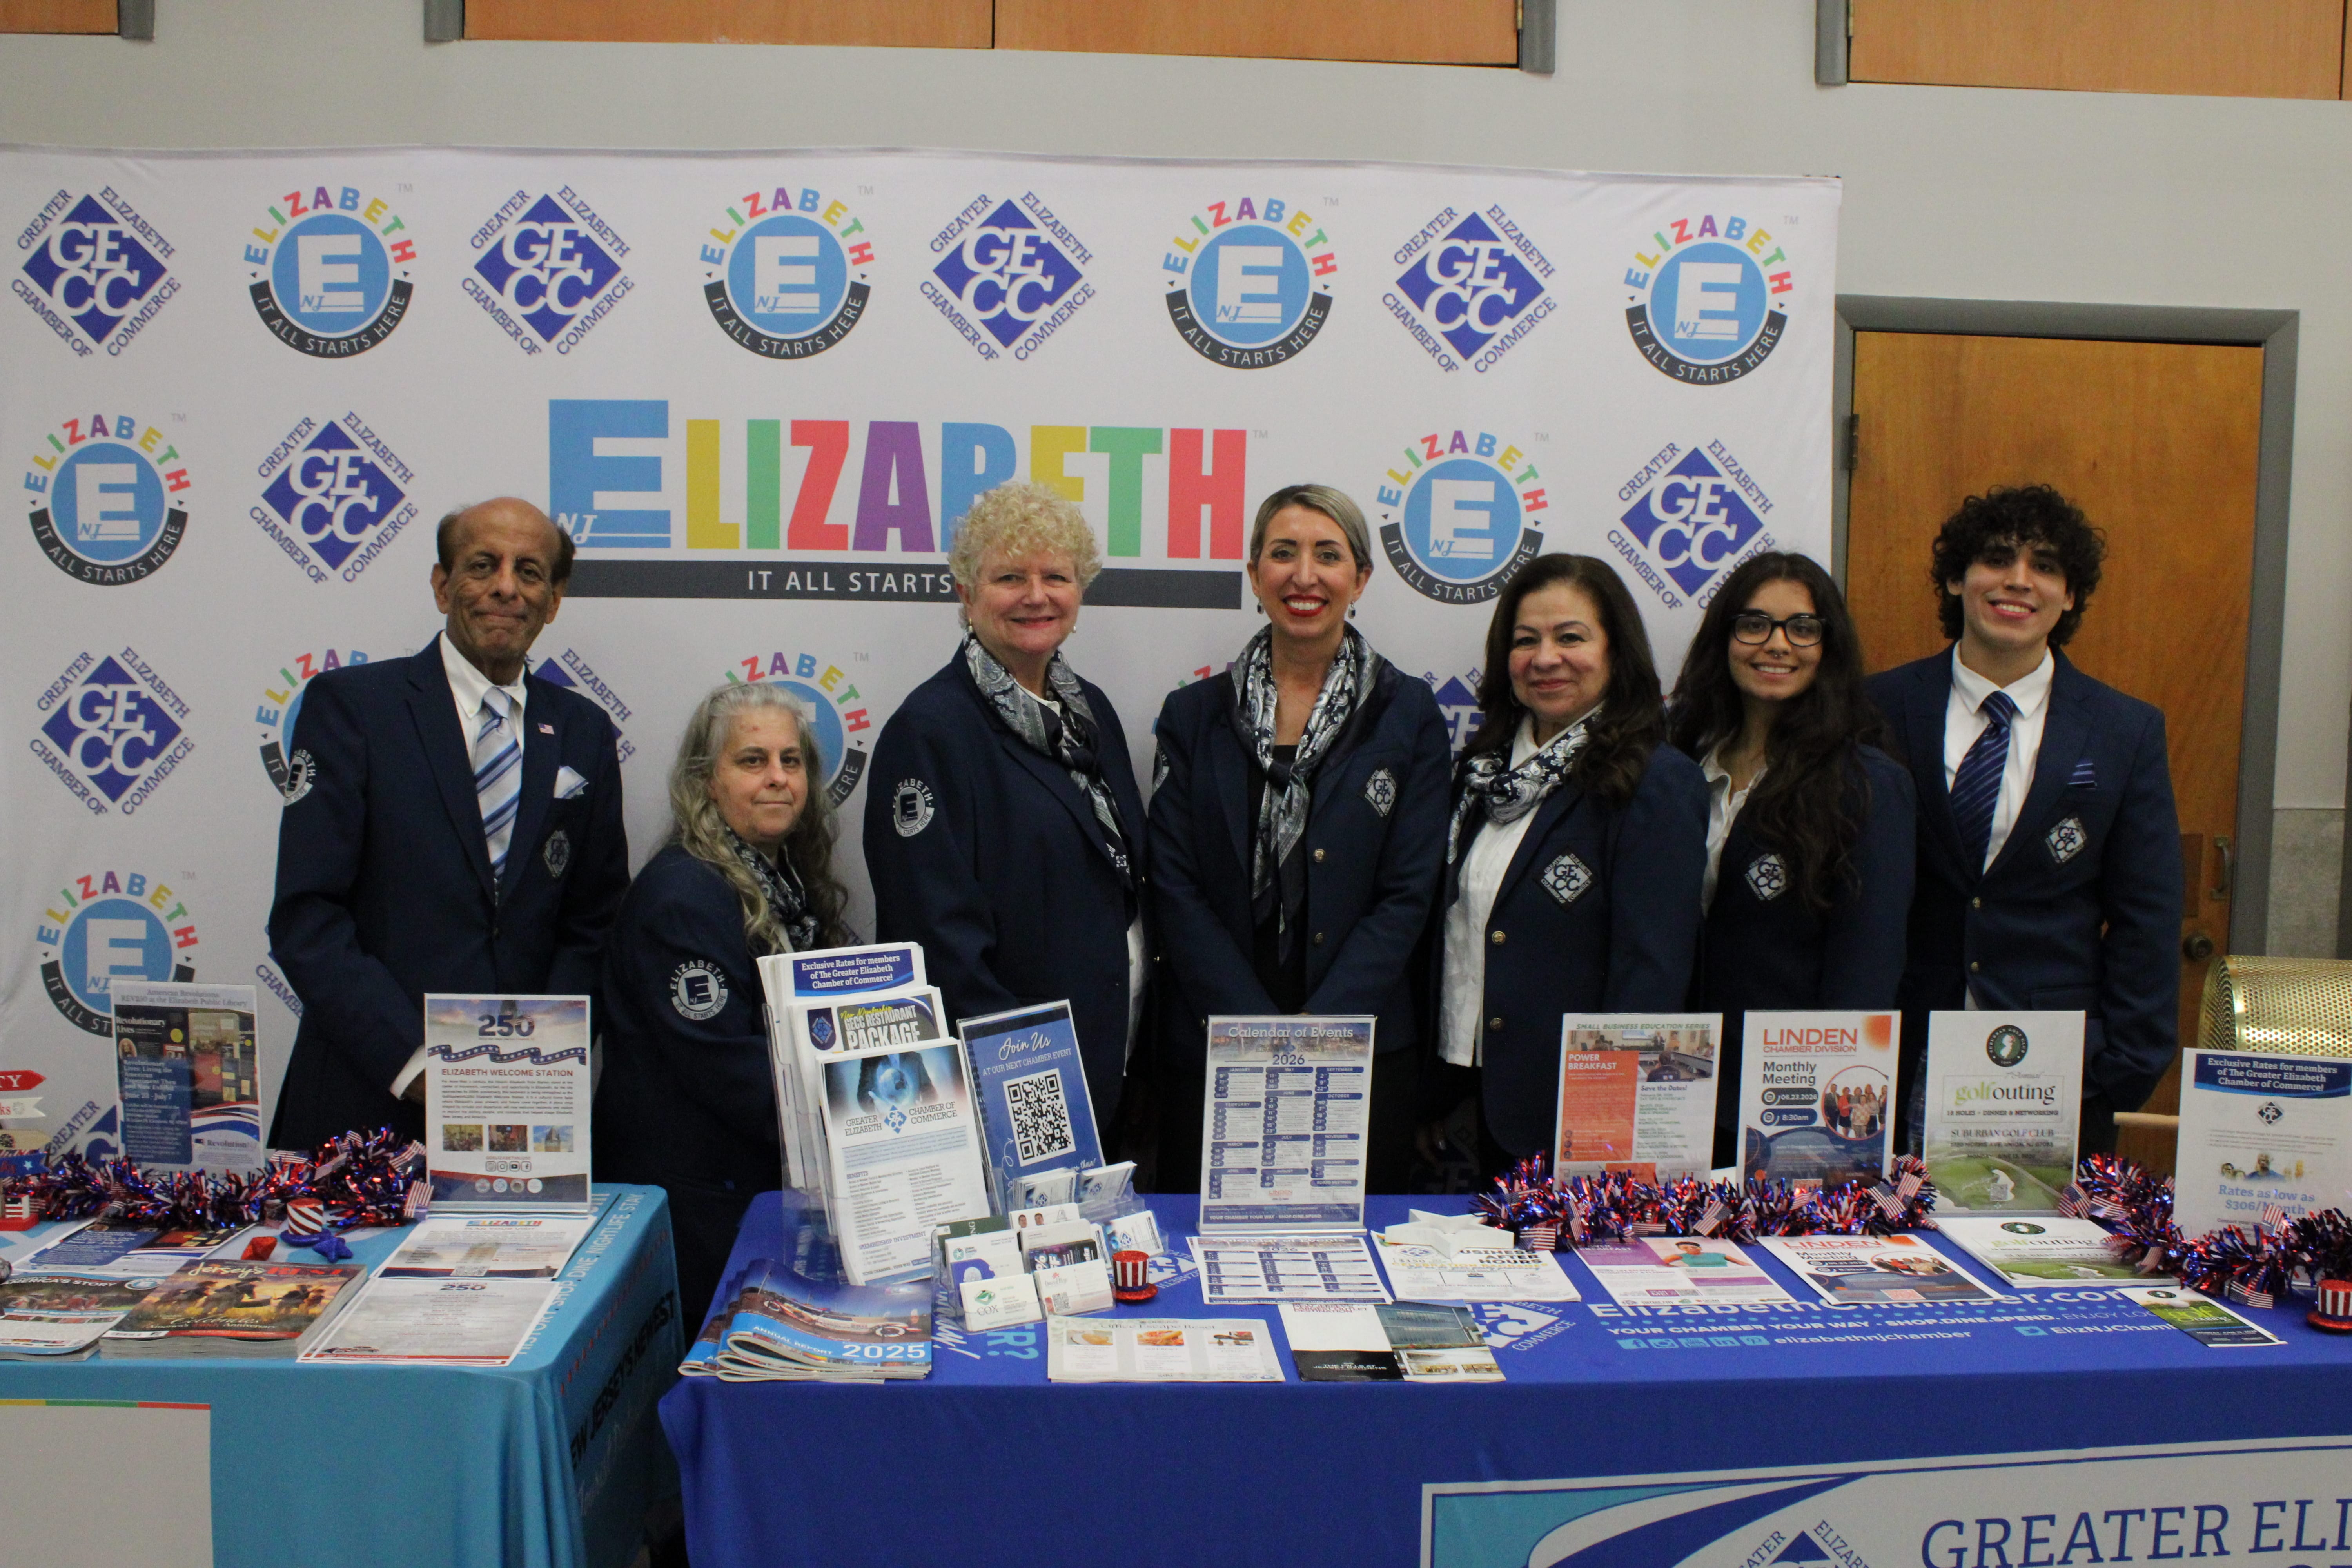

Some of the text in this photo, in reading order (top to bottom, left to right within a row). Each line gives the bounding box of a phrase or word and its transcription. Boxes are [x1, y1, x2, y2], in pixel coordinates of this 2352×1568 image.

[17, 185, 174, 258] GREATER ELIZABETH
[244, 187, 416, 265] ELIZABETH
[470, 185, 630, 257] GREATER ELIZABETH
[700, 188, 874, 265] ELIZABETH
[930, 191, 1093, 265] GREATER ELIZABETH
[1163, 197, 1338, 276] ELIZABETH
[1394, 204, 1555, 278] GREATER ELIZABETH
[1624, 214, 1794, 294] ELIZABETH
[258, 294, 405, 354] IT ALL STARTS HERE
[462, 278, 541, 355] CHAMBER OF
[557, 276, 634, 354] COMMERCE
[920, 281, 999, 361] CHAMBER OF
[1015, 284, 1096, 360] COMMERCE
[1475, 297, 1557, 372] COMMERCE
[1633, 321, 1779, 381] IT ALL STARTS HERE
[24, 415, 190, 493] ELIZABETH
[258, 412, 414, 483] GREATER ELIZABETH
[549, 399, 1247, 560] ELIZABETH
[1376, 431, 1547, 512] ELIZABETH
[1618, 438, 1773, 515] GREATER ELIZABETH
[748, 571, 951, 594] IT ALL STARTS
[38, 647, 191, 718] GREATER ELIZABETH
[560, 647, 632, 722] ELIZABETH
[36, 871, 198, 949] ELIZABETH
[670, 960, 725, 990] ELIZABETH
[801, 961, 834, 971] Exclusive
[836, 959, 855, 967] Rates
[867, 955, 900, 964] members
[832, 968, 859, 977] Greater
[860, 964, 893, 975] Elizabeth
[812, 979, 844, 989] Chamber
[854, 974, 893, 985] Commerce!
[478, 1014, 535, 1036] 250
[844, 1005, 917, 1031] GECC RESTAURANT
[1228, 1027, 1354, 1038] Calendar of Events
[999, 1031, 1051, 1061] Join Us
[1764, 1029, 1857, 1045] LINDEN
[983, 1048, 1071, 1076] AT OUR NEXT CHAMBER EVENT
[1272, 1054, 1305, 1065] 2026
[1764, 1061, 1817, 1073] Monthly
[2208, 1058, 2337, 1073] Exclusive Rates for members
[2229, 1068, 2244, 1077] The
[2247, 1070, 2282, 1079] Greater
[2283, 1072, 2326, 1082] Elizabeth
[1763, 1074, 1816, 1086] Meeting
[2218, 1077, 2324, 1091] Chamber of Commerce!
[846, 1115, 878, 1127] GREATER
[909, 1104, 944, 1116] CHAMBER
[911, 1110, 957, 1124] COMMERCE
[845, 1123, 882, 1136] ELIZABETH
[2218, 1185, 2315, 1202] Rates as low as
[587, 1194, 644, 1254] NIGHTLIFE STAY
[188, 1262, 265, 1278] Jersey's
[567, 1257, 597, 1278] DINE
[753, 1326, 926, 1359] ANNUAL REPORT 2025
[1669, 1325, 1766, 1333] CHAMBER
[1774, 1330, 1971, 1345] elizabethnjchamber
[1921, 1504, 2230, 1568] GREATER
